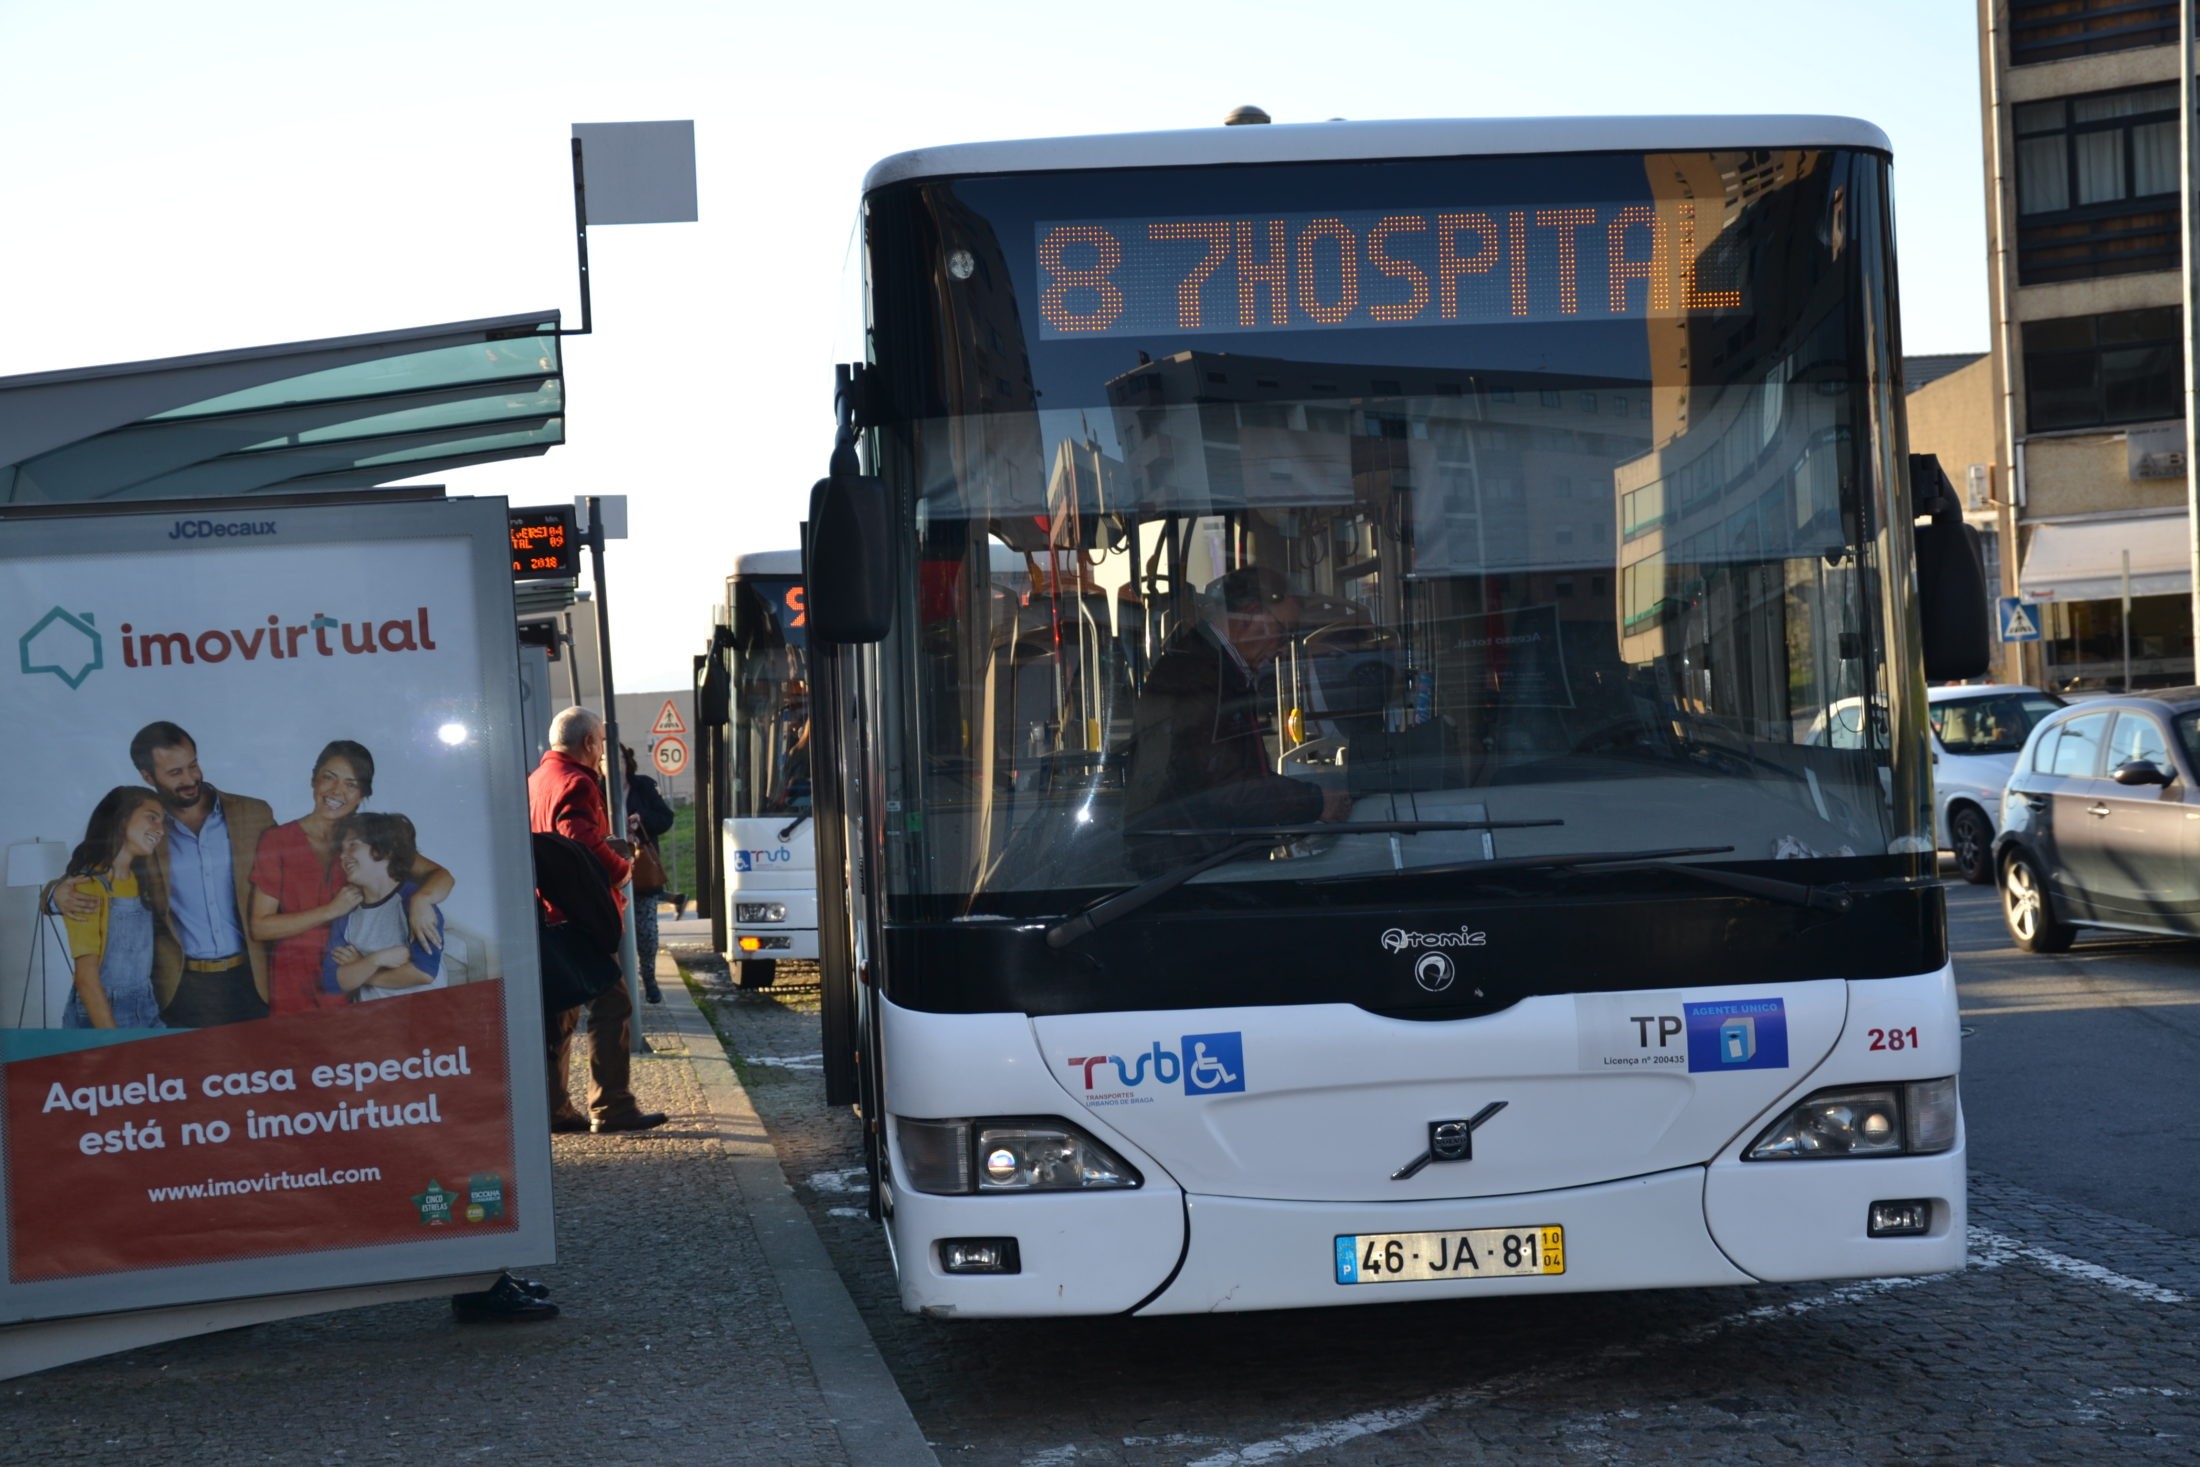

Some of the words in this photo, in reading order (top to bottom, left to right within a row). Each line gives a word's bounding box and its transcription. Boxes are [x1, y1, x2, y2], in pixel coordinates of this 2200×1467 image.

[168, 519, 278, 540] JCDecaux
[530, 557, 557, 569] 2018
[119, 607, 436, 668] imovirtual
[660, 748, 682, 763] 50
[1691, 1005, 1738, 1016] AGENTE
[1741, 1001, 1778, 1014] ÚNICO
[1630, 1015, 1682, 1048] TP
[1867, 1026, 1918, 1052] 281
[1604, 1055, 1640, 1066] Licença
[1653, 1055, 1685, 1065] 200435
[41, 1072, 187, 1117] Aquela
[201, 1065, 297, 1099] casa
[311, 1046, 471, 1091] especial
[1086, 1092, 1134, 1101] TRANSPORTES
[78, 1118, 165, 1157] está
[181, 1118, 230, 1146] no
[247, 1094, 441, 1140] imovirtual
[147, 1164, 381, 1203] www.imovirtual.com
[1343, 1265, 1351, 1275] P
[1542, 1232, 1560, 1244] 10
[1543, 1254, 1560, 1267] 04
